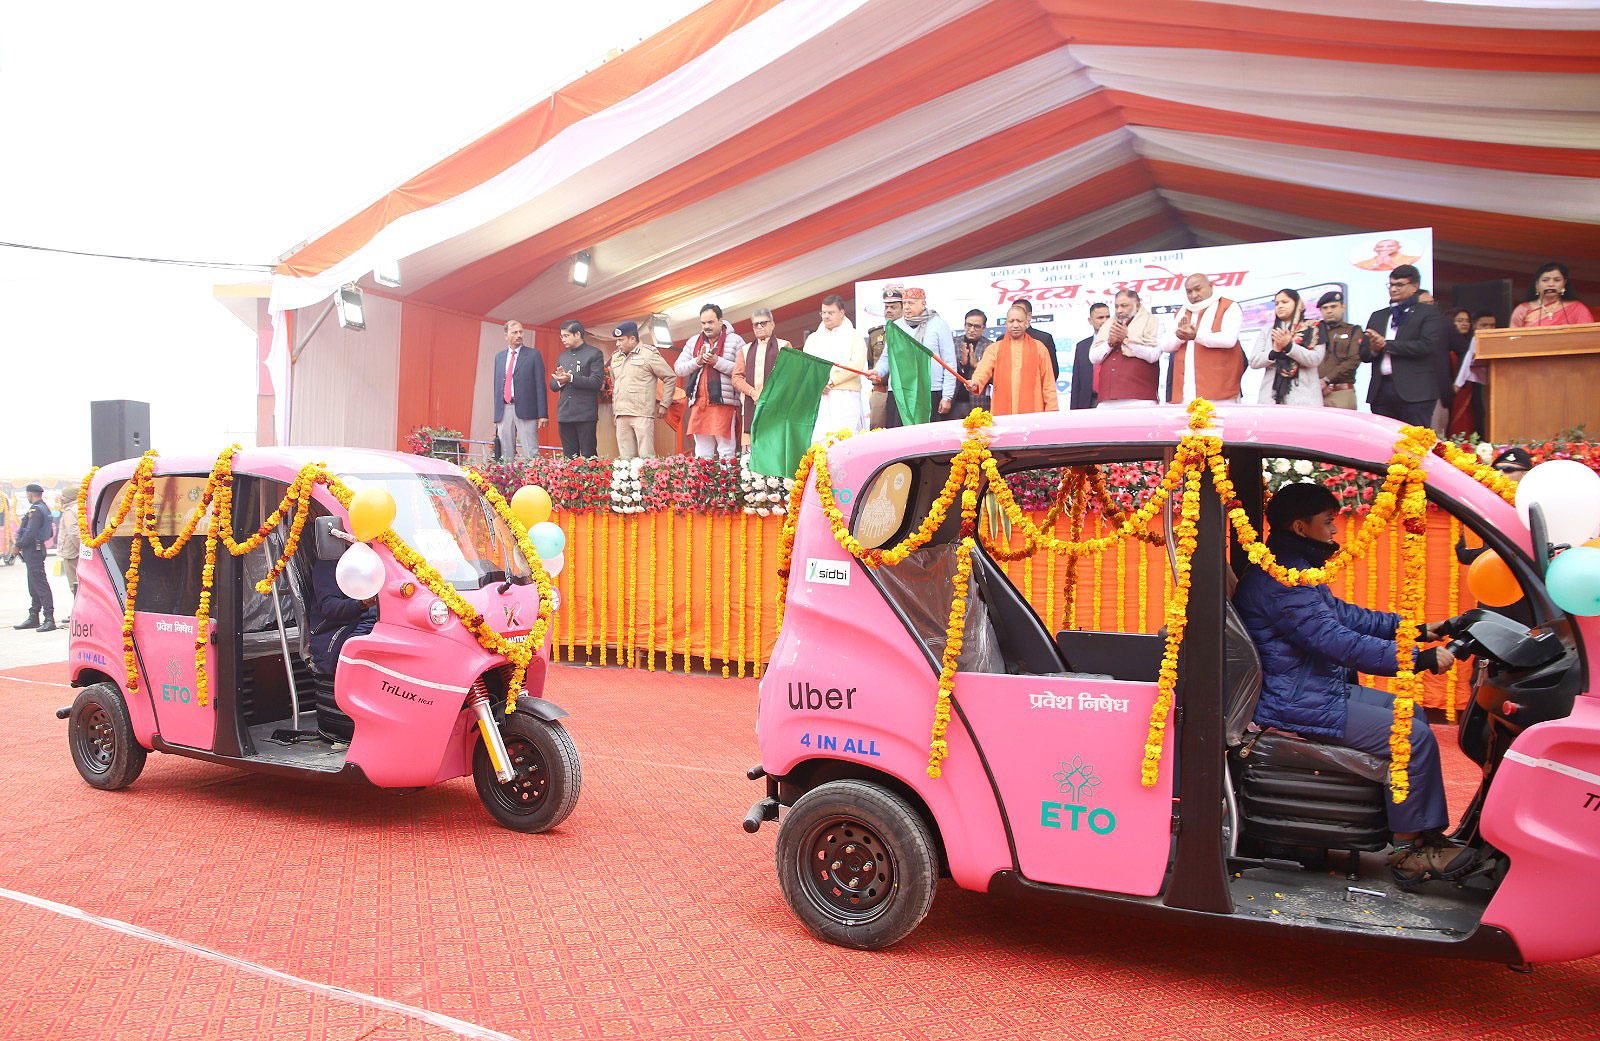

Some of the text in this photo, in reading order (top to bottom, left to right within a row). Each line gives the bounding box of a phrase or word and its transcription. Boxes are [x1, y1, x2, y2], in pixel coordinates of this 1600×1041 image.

[831, 487, 853, 504] TO
[819, 568, 848, 581] sidbi
[71, 619, 94, 638] Uber
[83, 652, 92, 663] IN
[93, 655, 107, 666] ALL
[162, 683, 191, 705] ETO
[381, 680, 418, 702] TriLux
[788, 682, 857, 711] Uber
[1029, 690, 1130, 713] प्रवेश निषेध
[800, 733, 881, 757] 4 IN ALL
[1041, 800, 1117, 835] ETO
